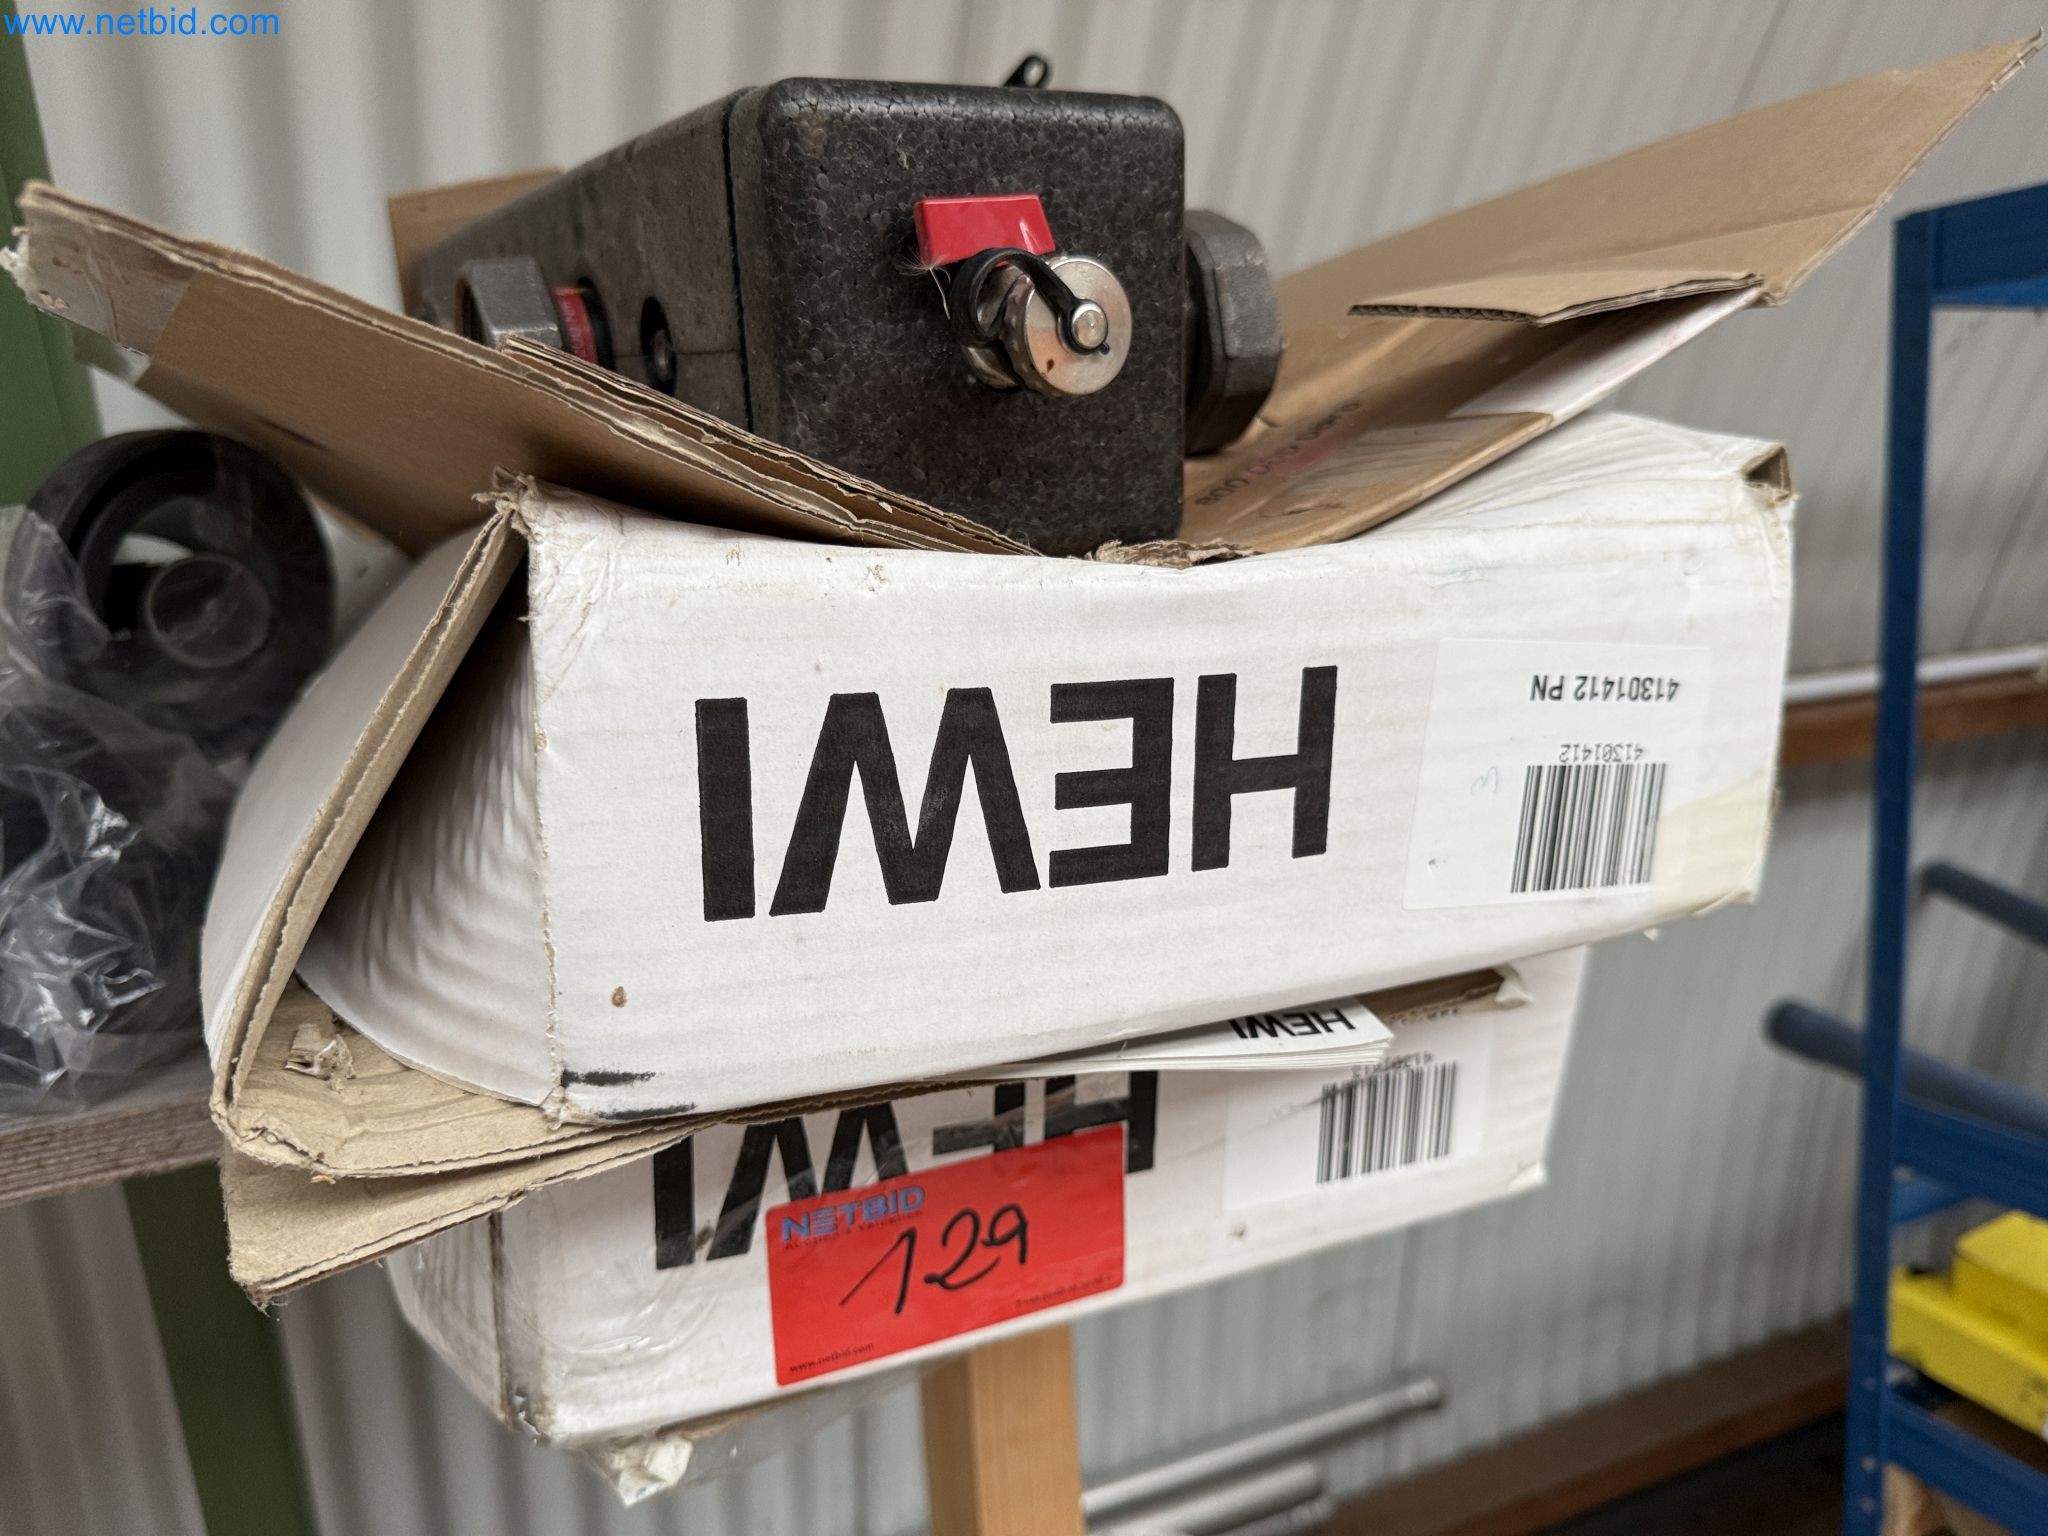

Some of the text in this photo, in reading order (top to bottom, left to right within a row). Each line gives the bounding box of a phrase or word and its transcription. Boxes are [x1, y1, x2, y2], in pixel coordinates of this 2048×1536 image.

[1530, 674, 1680, 702] 41301412 PN
[1558, 743, 1645, 763] 41301412
[695, 666, 1338, 922] HEWI
[1228, 1007, 1356, 1039] HEWI
[781, 1185, 926, 1244] NETBID
[838, 1203, 1029, 1315] 129
